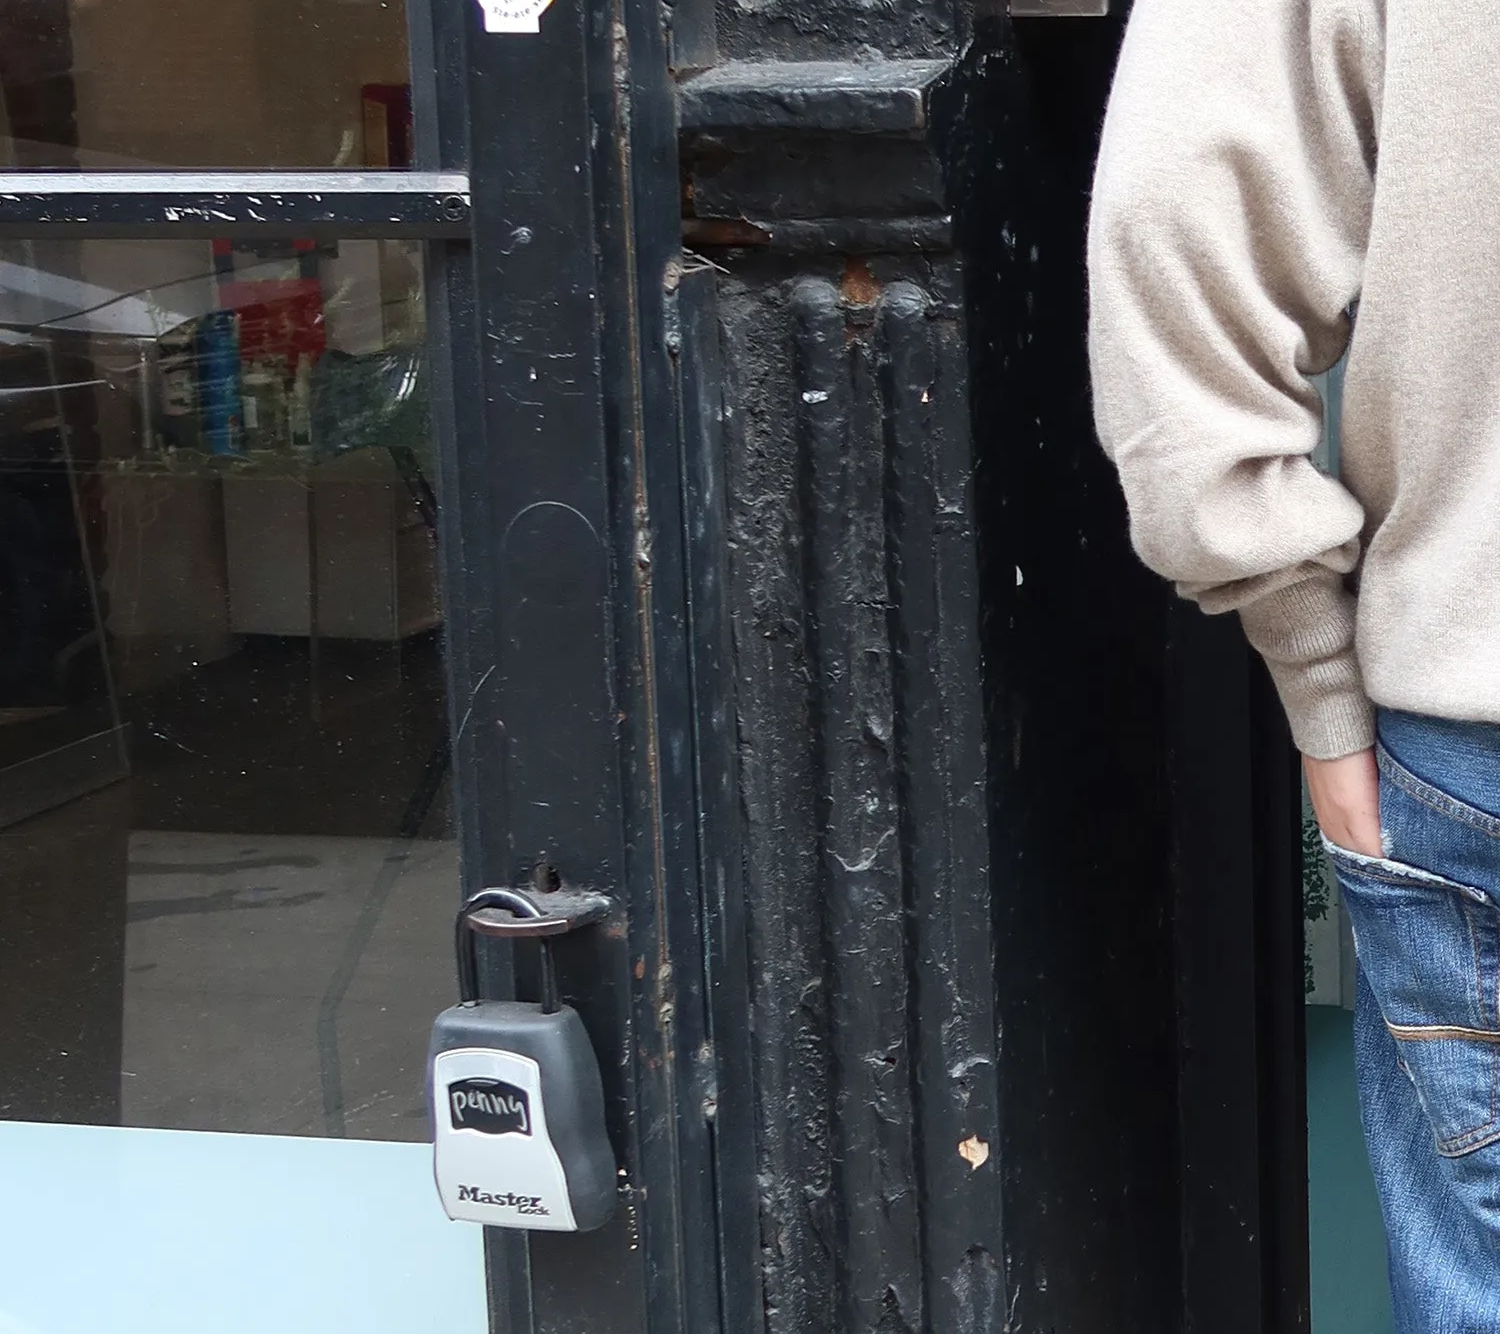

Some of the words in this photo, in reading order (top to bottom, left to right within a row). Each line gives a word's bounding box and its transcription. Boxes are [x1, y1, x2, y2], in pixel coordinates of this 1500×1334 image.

[451, 1089, 528, 1132] penny
[458, 1183, 543, 1208] Master
[517, 1204, 550, 1216] Lock
